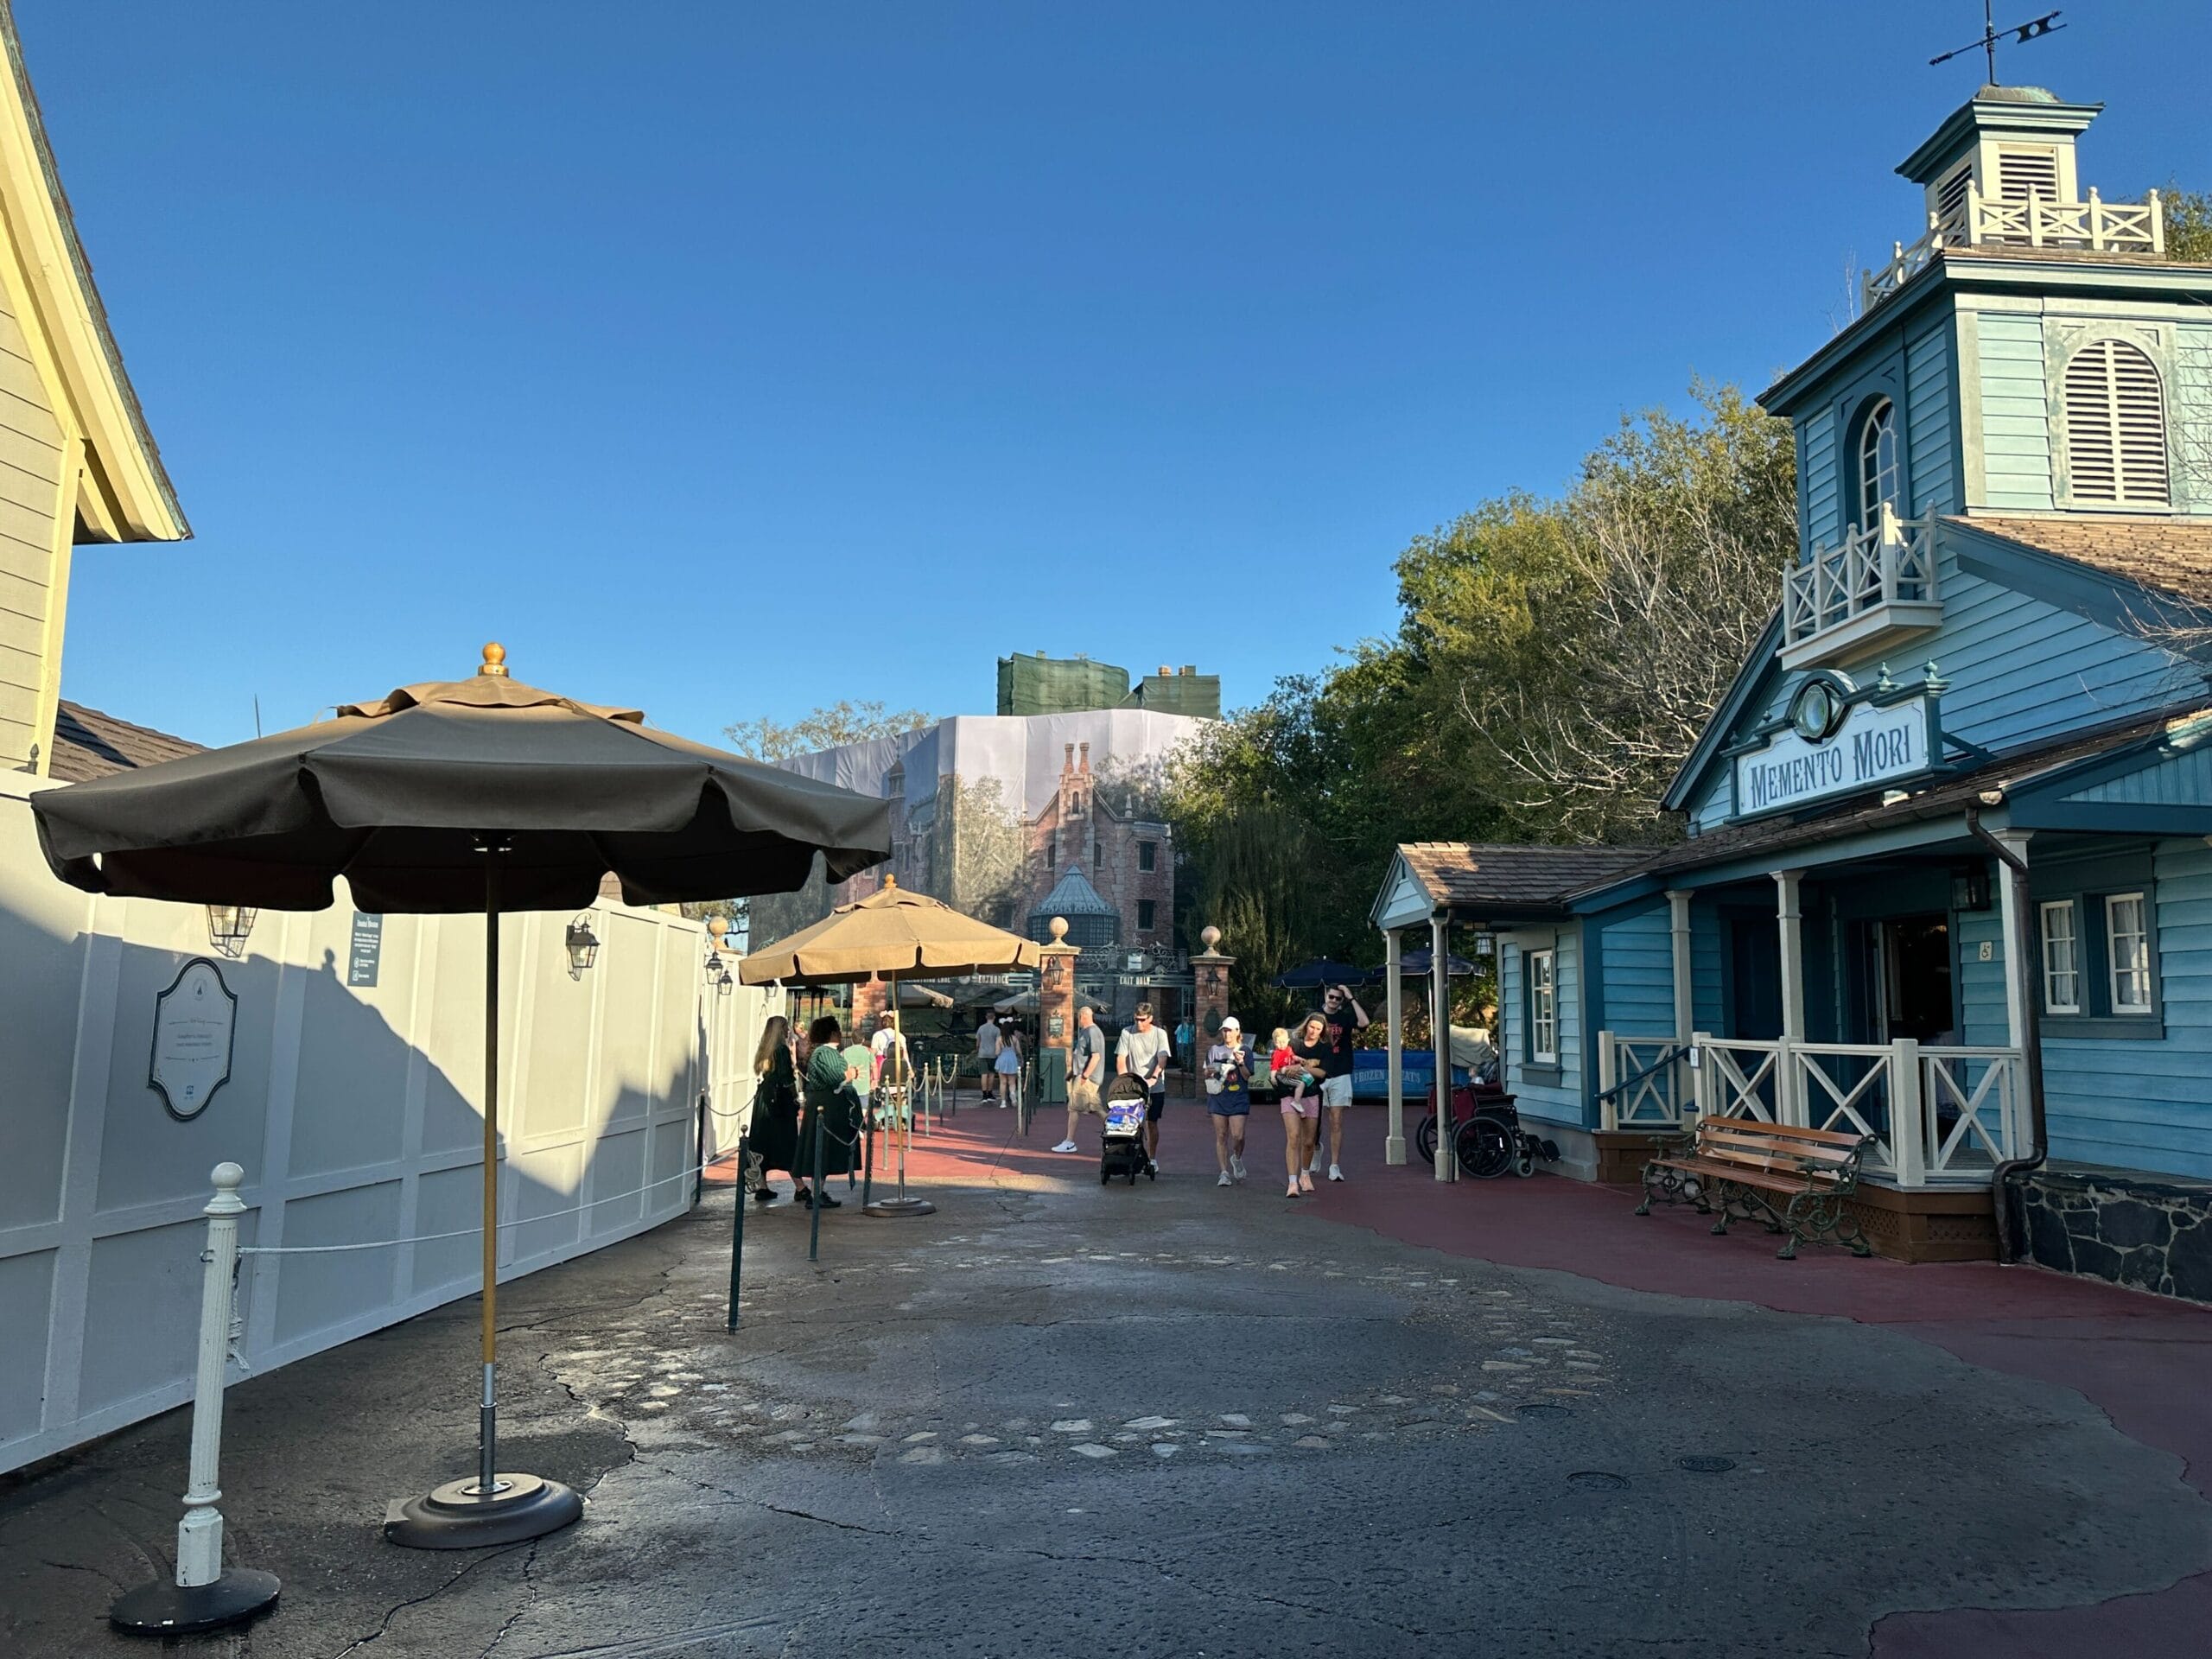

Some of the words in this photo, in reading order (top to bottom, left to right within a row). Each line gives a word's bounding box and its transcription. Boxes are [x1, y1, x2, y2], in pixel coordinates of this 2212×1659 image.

[1751, 746, 1842, 809] MEMENTO
[1853, 725, 1911, 782] MORI
[1354, 1070, 1384, 1084] FROZEN
